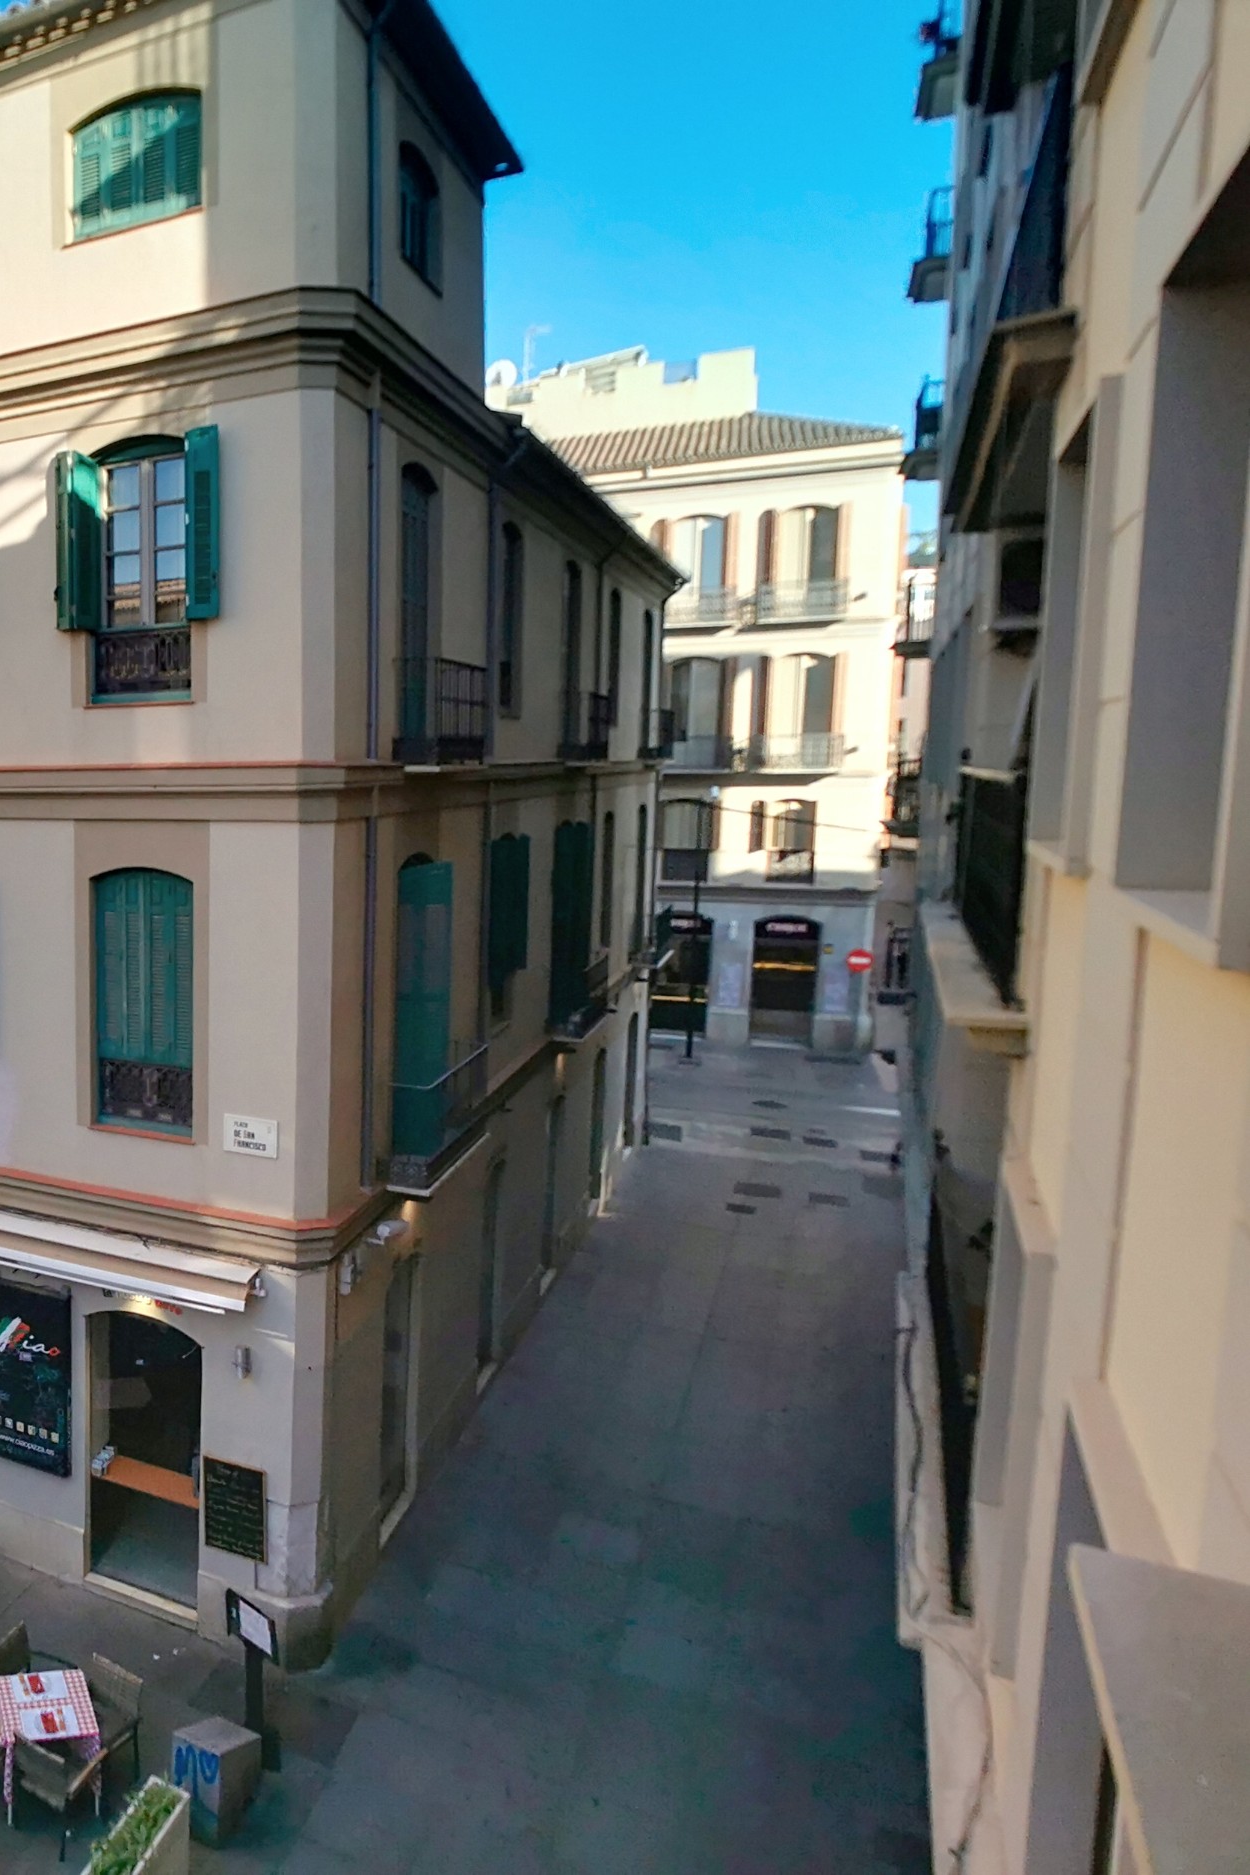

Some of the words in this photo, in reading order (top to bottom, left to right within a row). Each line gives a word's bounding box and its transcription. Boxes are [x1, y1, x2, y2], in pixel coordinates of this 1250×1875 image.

[233, 1129, 242, 1138] DE
[243, 1130, 255, 1139] SAN
[233, 1138, 266, 1151] FRANCISCO
